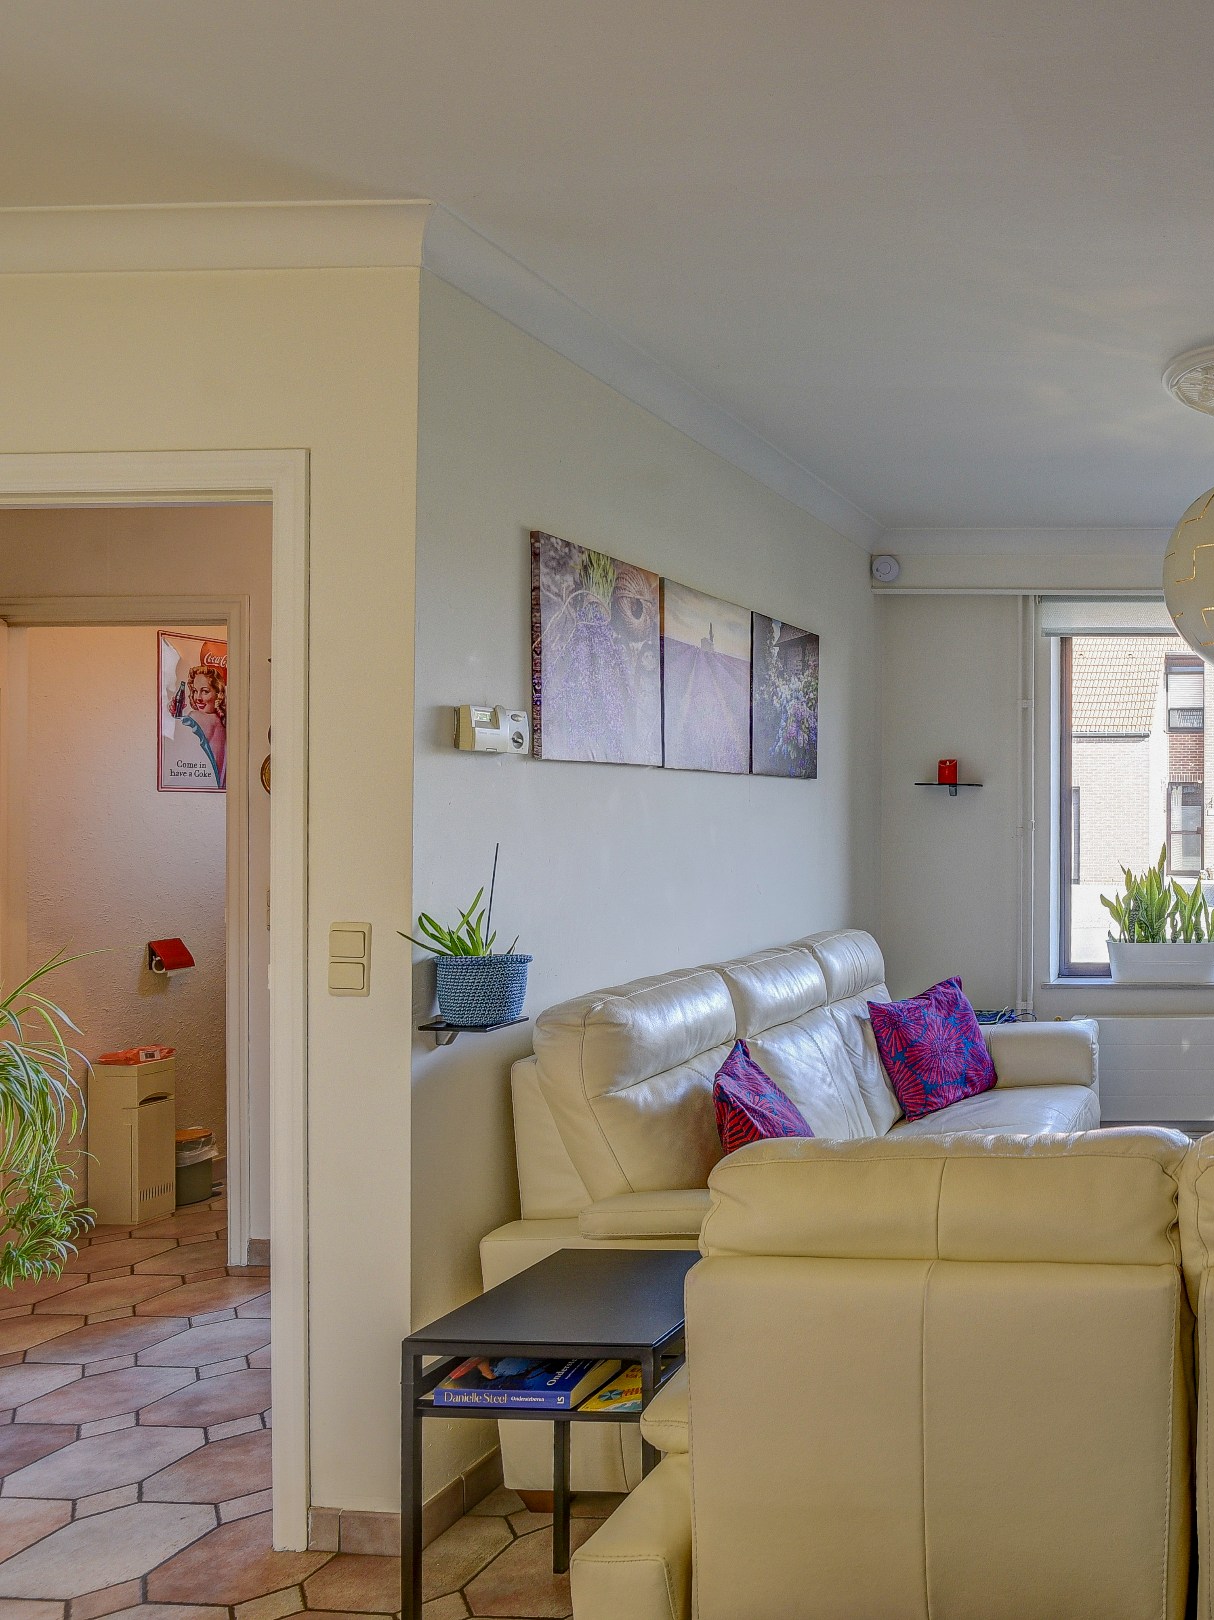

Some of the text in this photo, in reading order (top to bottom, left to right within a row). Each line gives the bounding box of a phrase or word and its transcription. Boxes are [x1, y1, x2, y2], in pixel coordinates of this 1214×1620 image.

[176, 760, 207, 769] Come in
[170, 769, 187, 777] have
[194, 769, 212, 778] Coke
[444, 1391, 508, 1405] Danielle Steel
